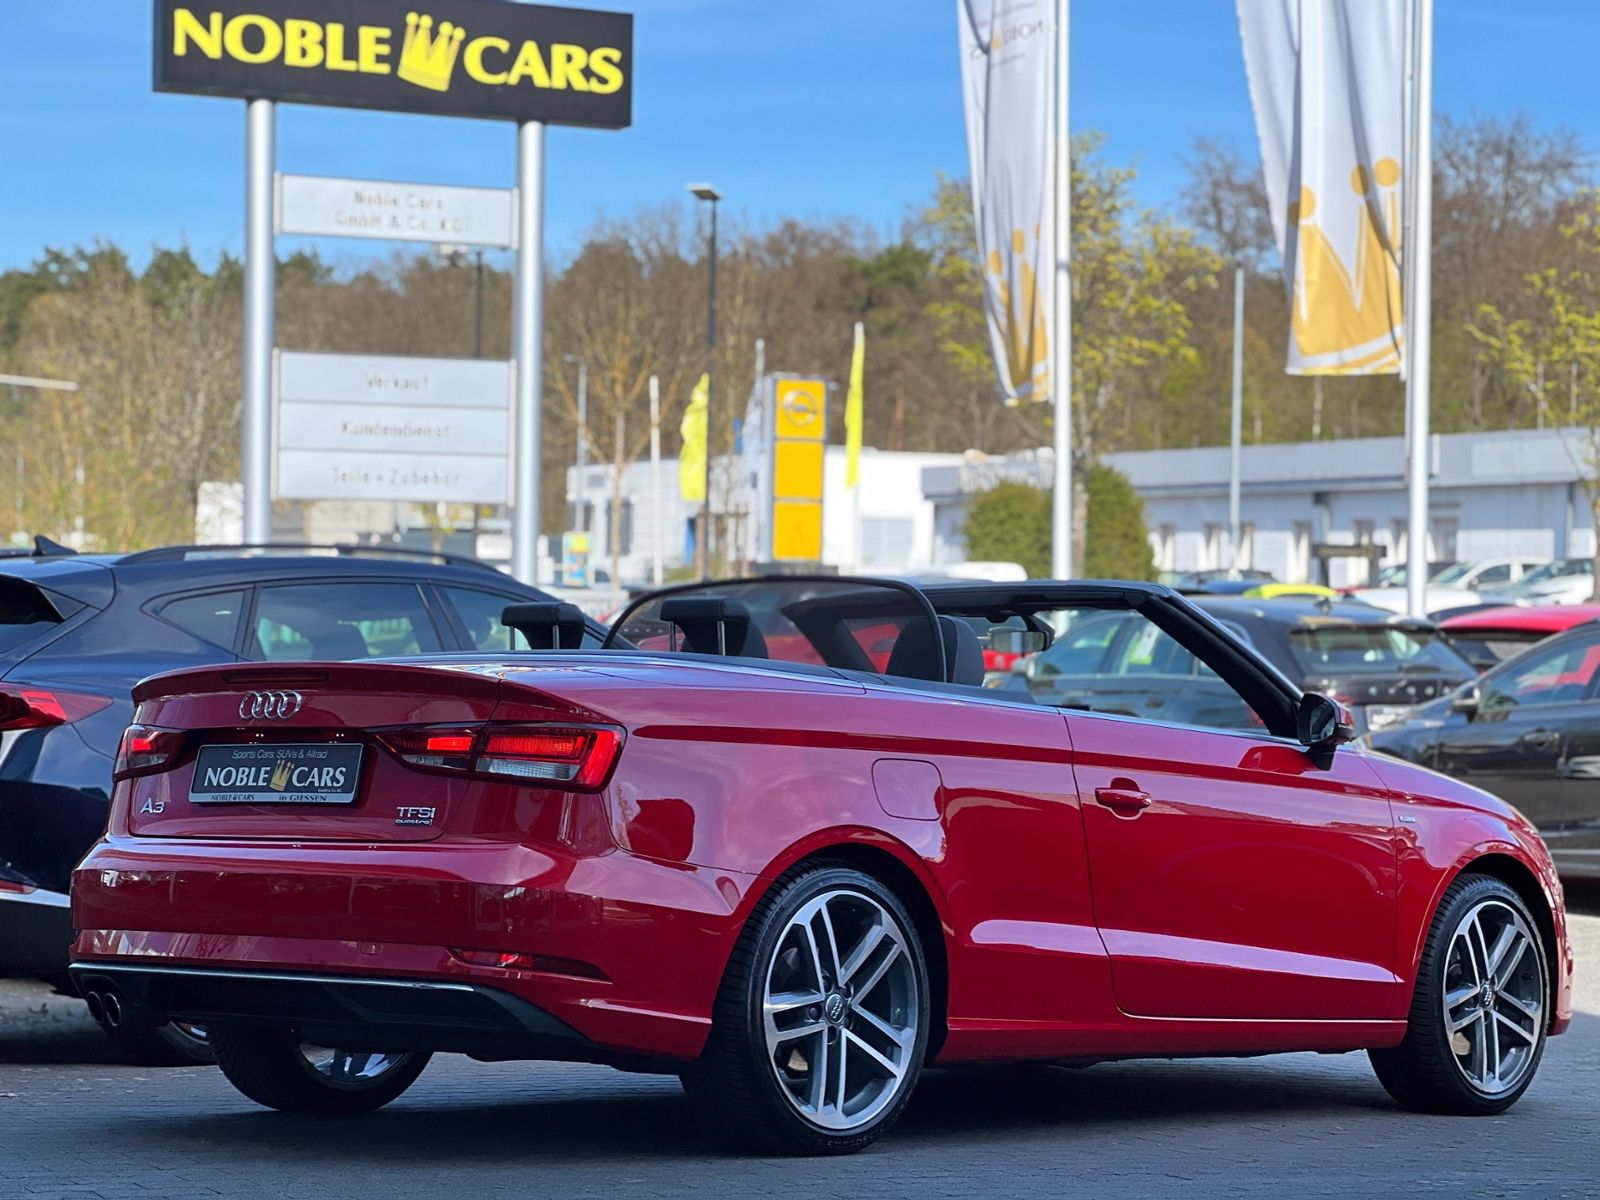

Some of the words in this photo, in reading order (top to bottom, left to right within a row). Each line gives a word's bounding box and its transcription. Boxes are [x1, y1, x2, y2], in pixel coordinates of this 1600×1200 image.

[173, 8, 392, 75] NOBLE
[463, 36, 625, 95] CARS
[232, 749, 255, 760] Sports
[276, 749, 297, 759] SUVs
[298, 749, 304, 759] &
[306, 749, 329, 759] Allrad
[204, 766, 271, 787] NOBLE
[291, 766, 347, 787] CARS
[279, 793, 287, 801] in
[289, 794, 327, 802] GIESSEN
[140, 797, 165, 813] A3
[397, 806, 436, 818] TFSI
